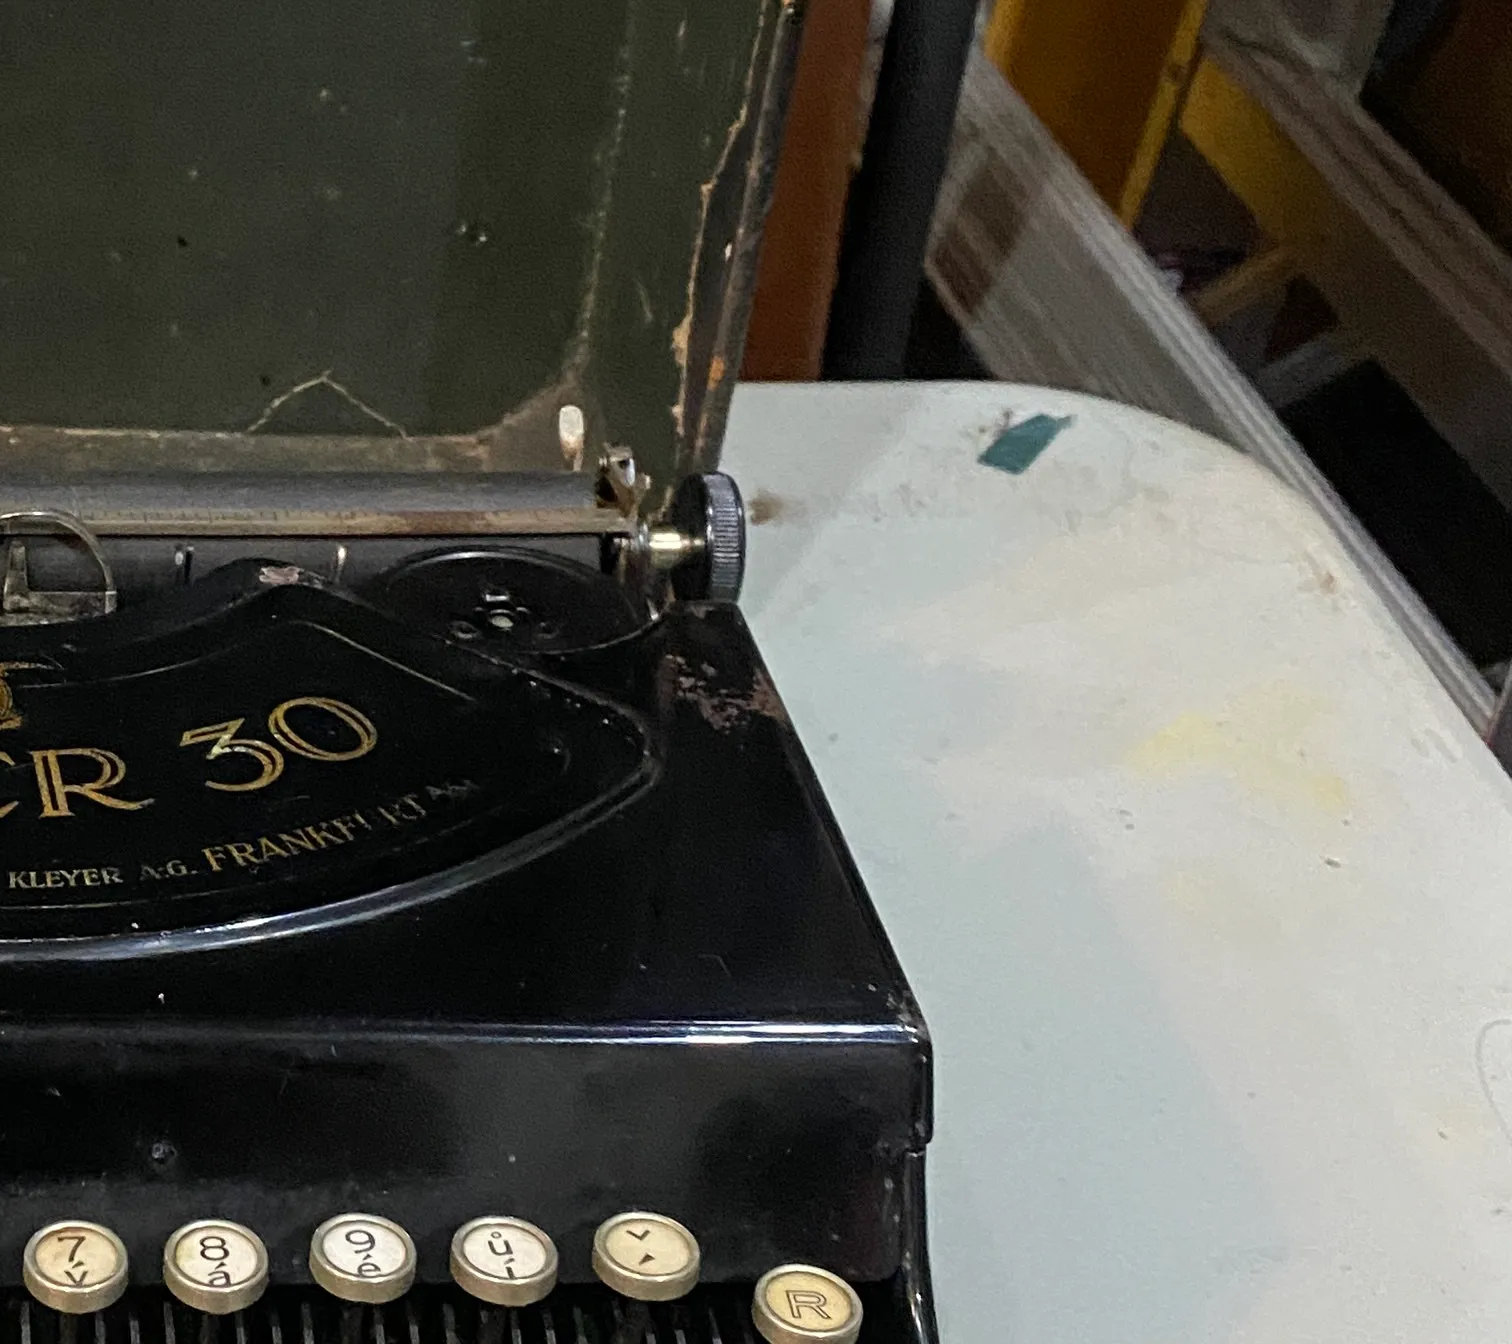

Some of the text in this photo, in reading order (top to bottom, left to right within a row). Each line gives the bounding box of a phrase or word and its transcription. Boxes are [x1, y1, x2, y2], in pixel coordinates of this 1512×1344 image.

[180, 696, 378, 792] 30
[8, 866, 124, 890] KLEYER
[57, 1236, 86, 1263] 7
[199, 1236, 230, 1261] 8
[345, 1229, 376, 1254] 9
[785, 1289, 832, 1320] R
